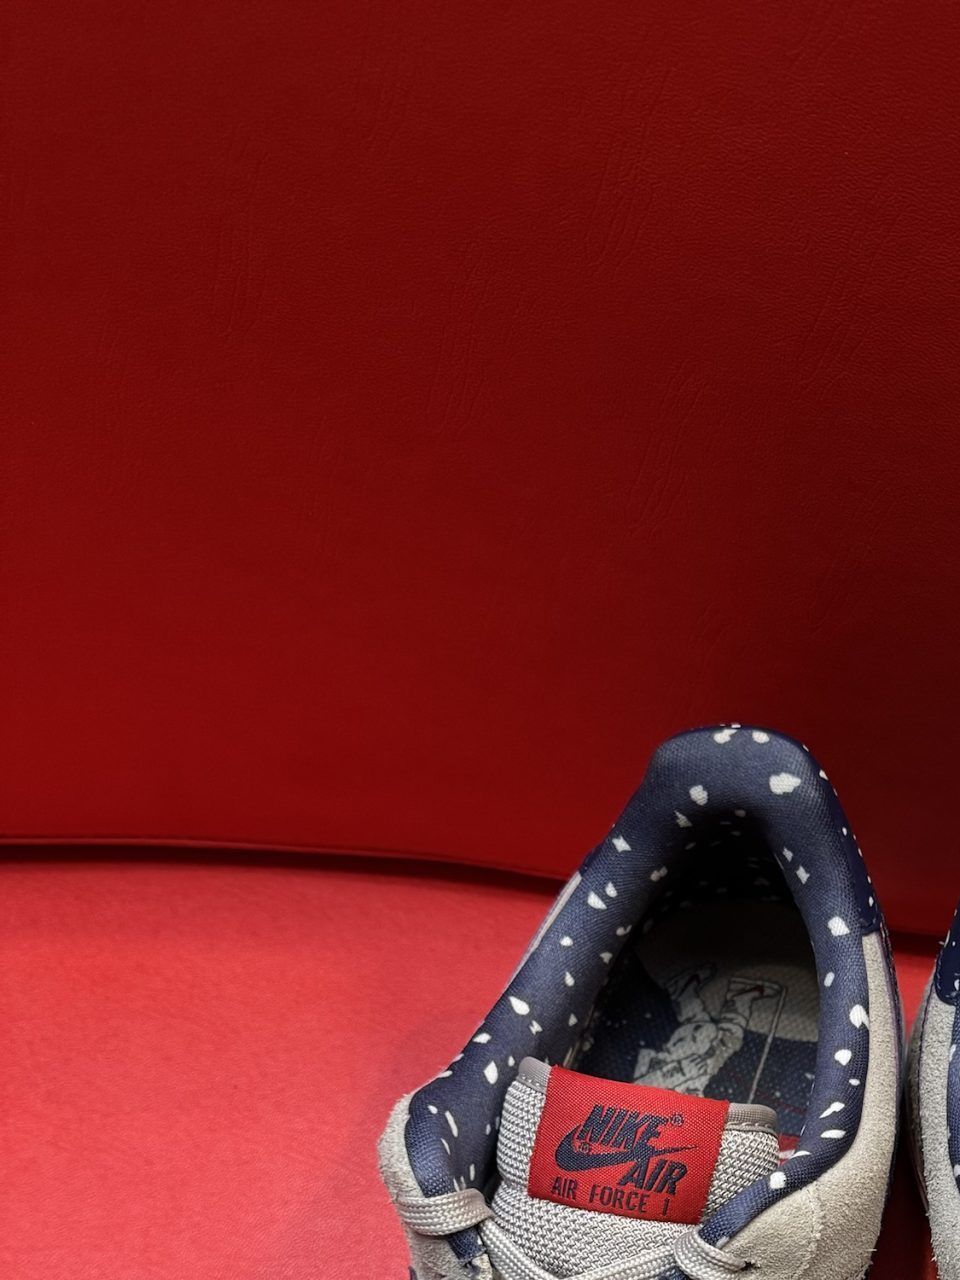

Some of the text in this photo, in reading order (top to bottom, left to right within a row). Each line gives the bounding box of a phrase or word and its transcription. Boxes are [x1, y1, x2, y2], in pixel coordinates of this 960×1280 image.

[577, 1104, 670, 1152] NIKE
[551, 1177, 577, 1200] AIR
[590, 1184, 650, 1213] FORCE
[618, 1160, 688, 1196] AIR
